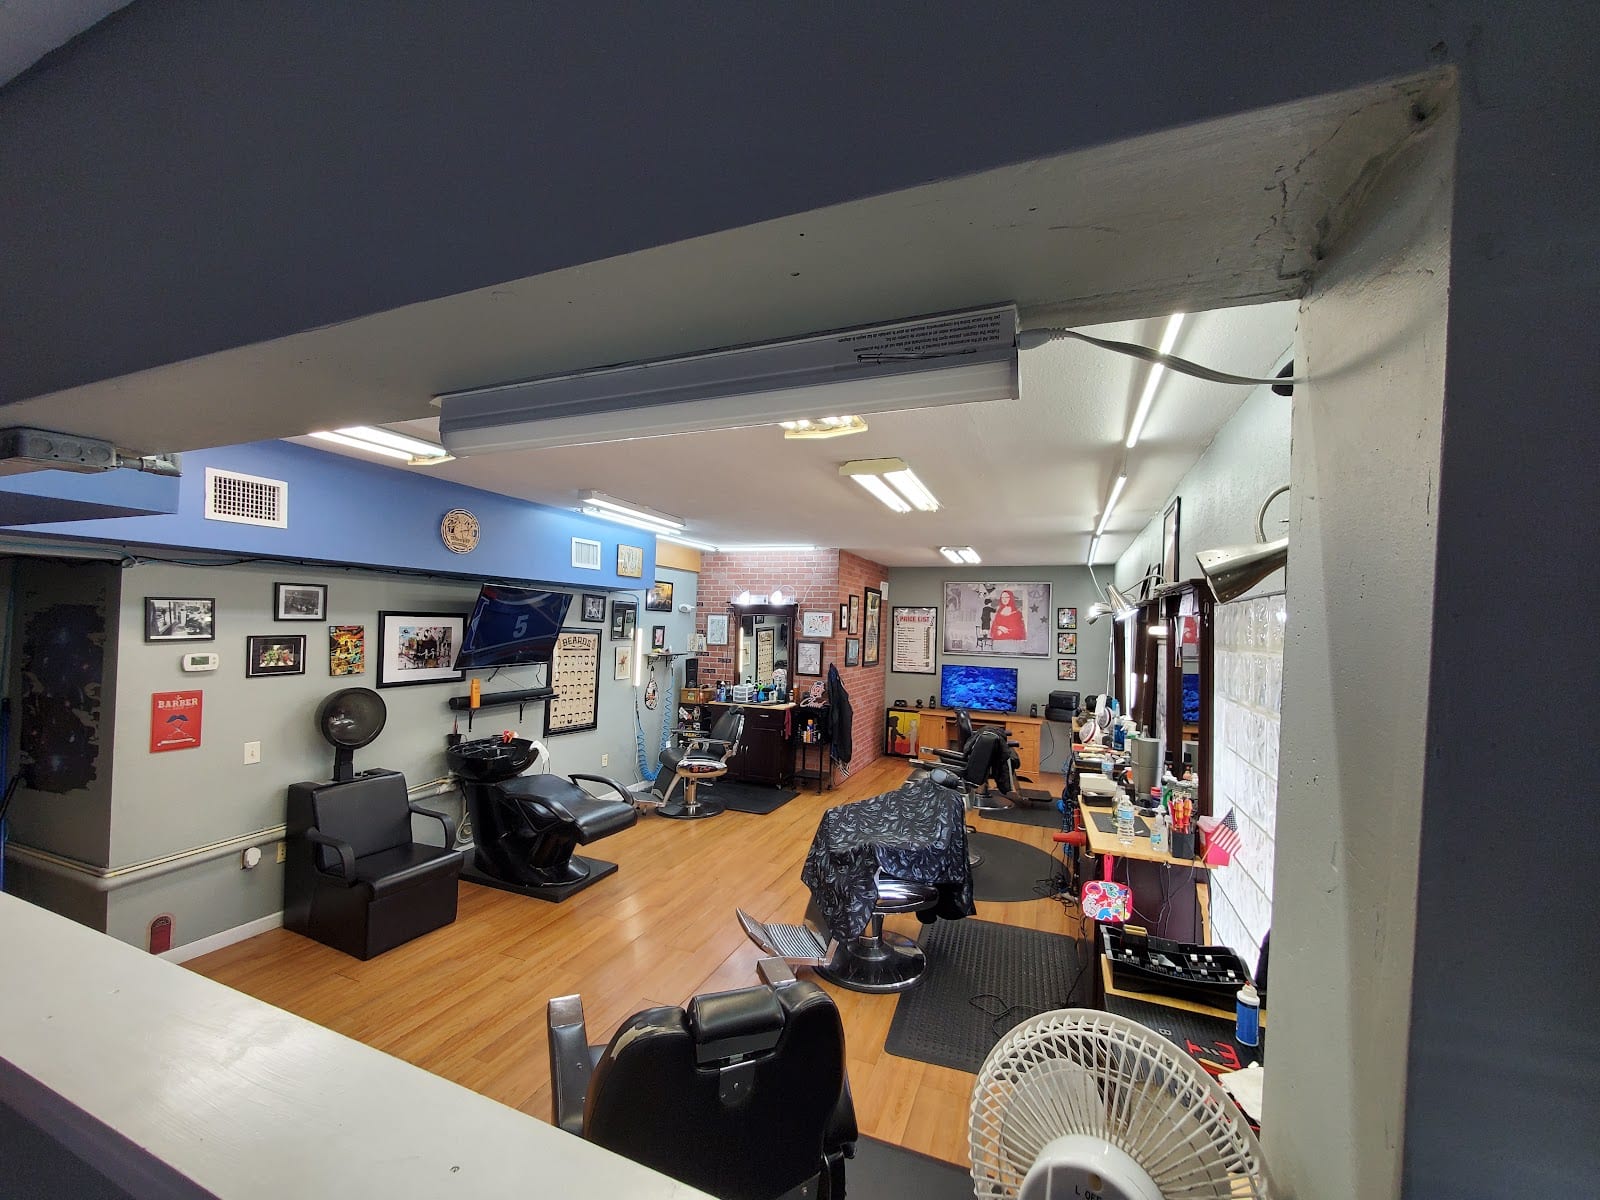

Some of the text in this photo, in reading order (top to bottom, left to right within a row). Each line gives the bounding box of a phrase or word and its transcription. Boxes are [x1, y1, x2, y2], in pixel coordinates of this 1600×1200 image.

[899, 615, 916, 623] PRICE
[512, 614, 529, 638] 5
[562, 636, 592, 647] BEARDS
[157, 697, 198, 709] BARBER
